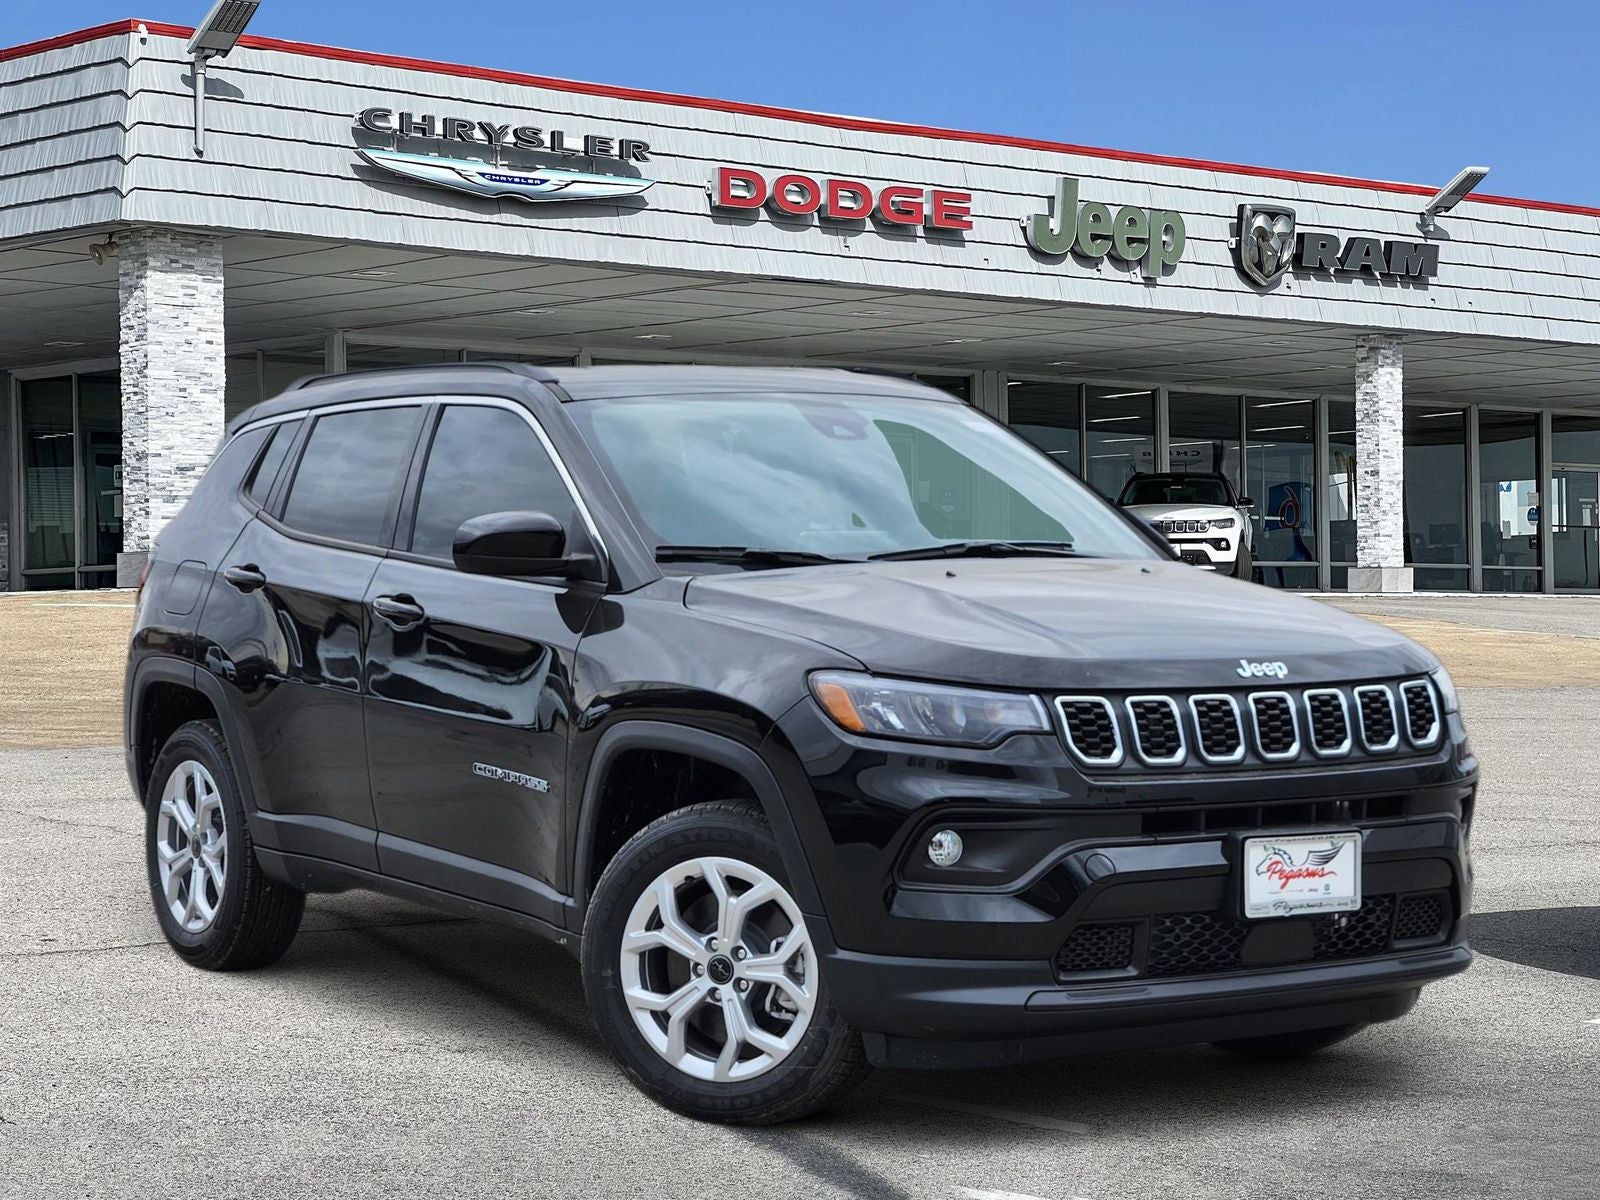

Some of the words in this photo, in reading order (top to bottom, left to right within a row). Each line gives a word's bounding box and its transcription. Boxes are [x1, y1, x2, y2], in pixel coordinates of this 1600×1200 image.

[358, 106, 652, 163] CHRYSLER
[484, 174, 541, 185] CHRYSLER
[712, 166, 974, 231] DODGE
[1026, 176, 1187, 279] Jeep
[1302, 231, 1440, 277] RAM
[1236, 659, 1288, 679] Jeep
[473, 762, 550, 793] COMPASS
[1266, 860, 1337, 890] Pegasus
